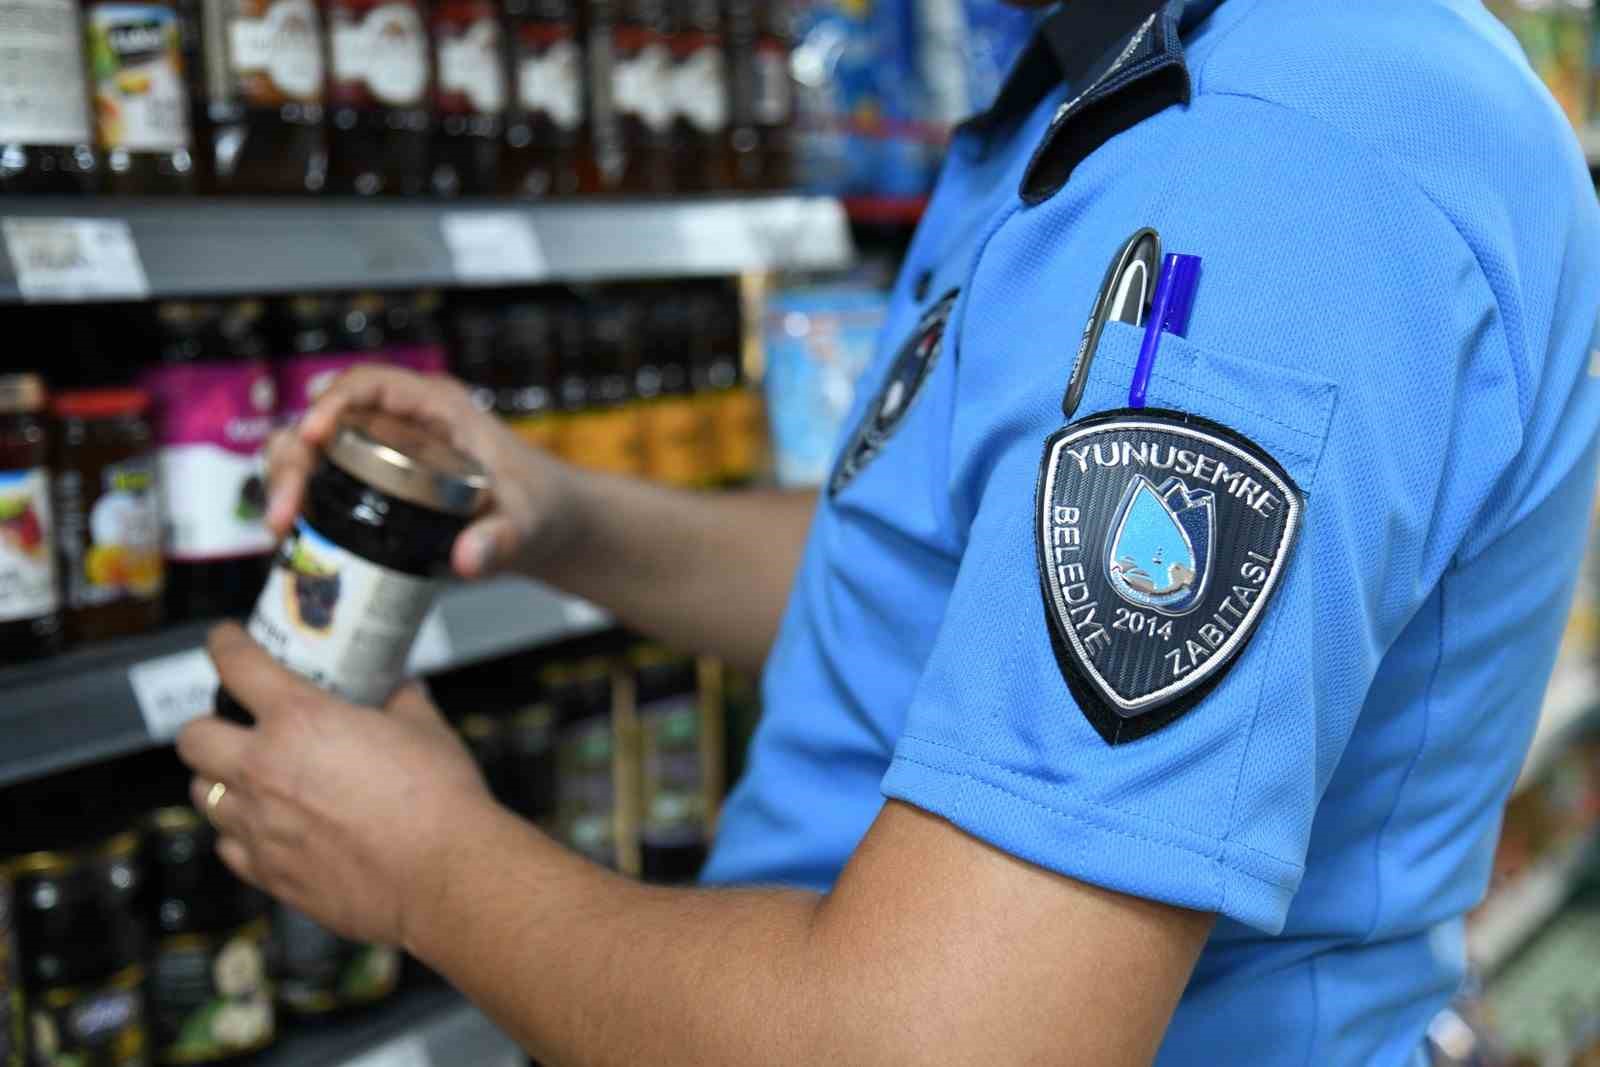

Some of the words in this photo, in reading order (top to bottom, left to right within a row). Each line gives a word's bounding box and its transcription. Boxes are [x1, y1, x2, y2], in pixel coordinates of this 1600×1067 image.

[1067, 441, 1280, 518] YUNUSEMRE
[1054, 505, 1111, 657] BELEDIYE
[1112, 607, 1173, 641] 2014
[1165, 550, 1273, 678] ZABITASI
